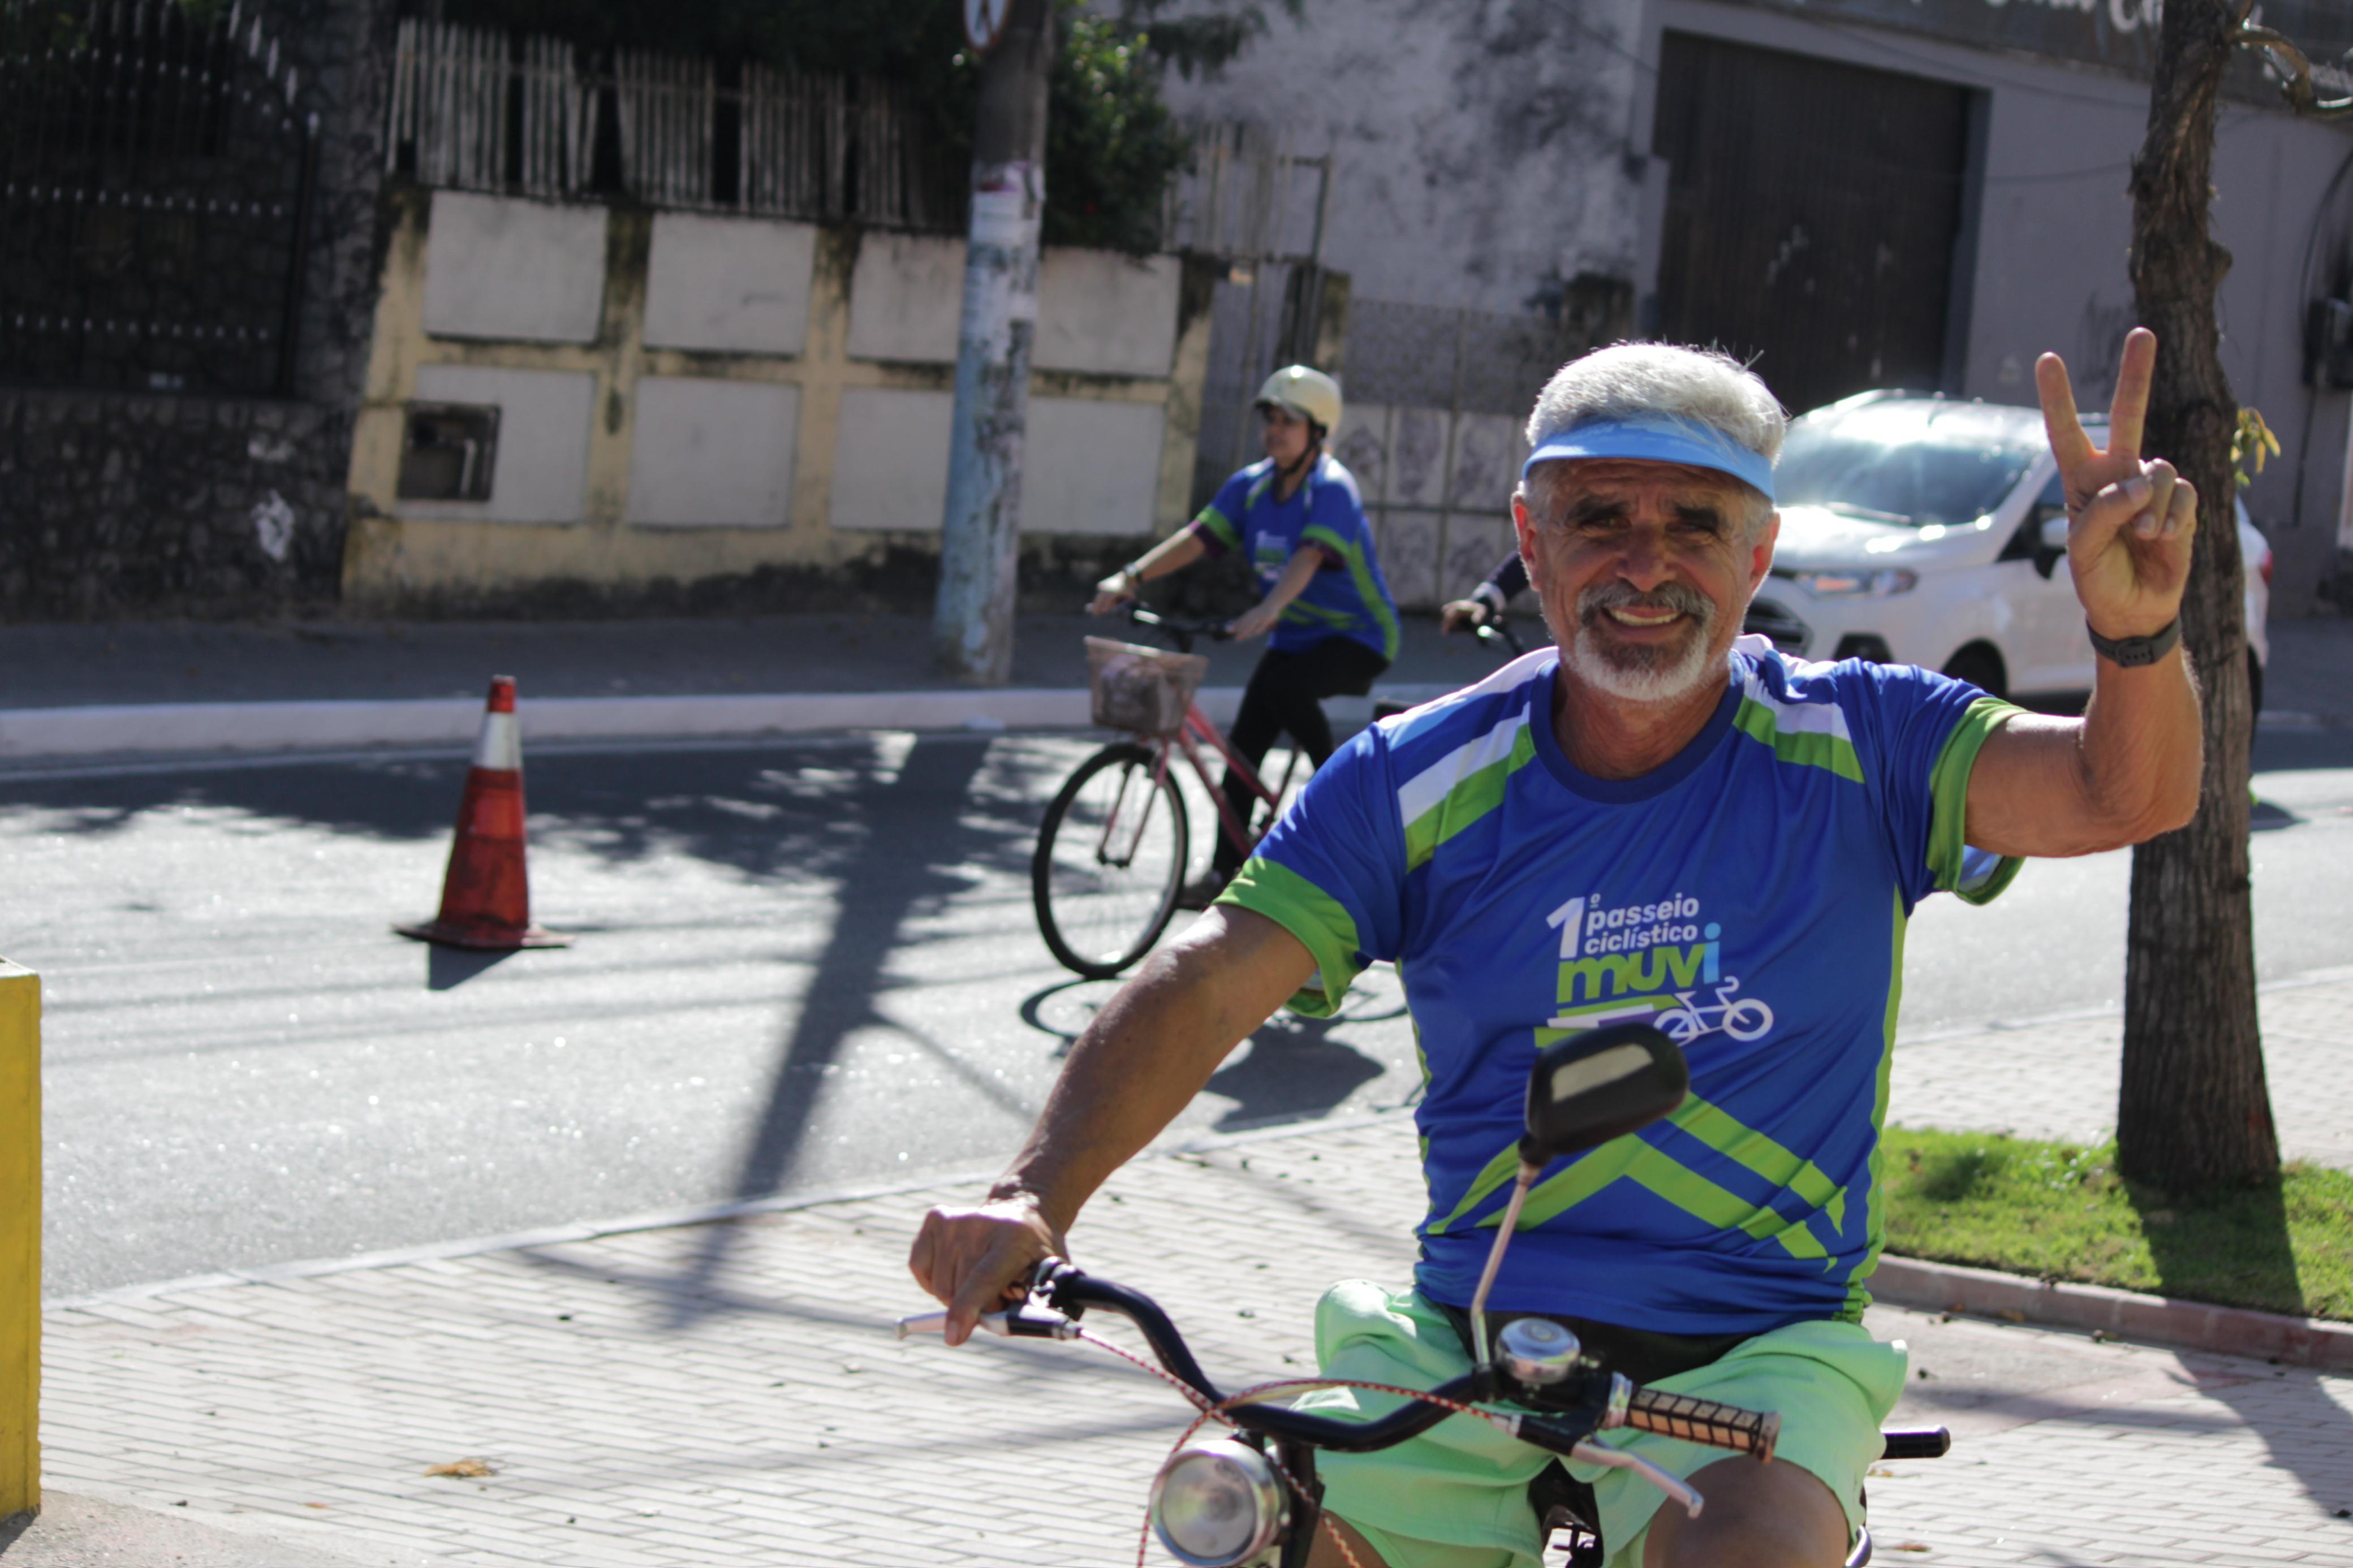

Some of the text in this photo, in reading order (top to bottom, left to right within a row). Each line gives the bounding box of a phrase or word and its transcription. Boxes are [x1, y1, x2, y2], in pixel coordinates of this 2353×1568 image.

[1586, 892, 1699, 936] passeio
[1584, 922, 1699, 954] ciclístico
[1557, 922, 1721, 1004] muvi
